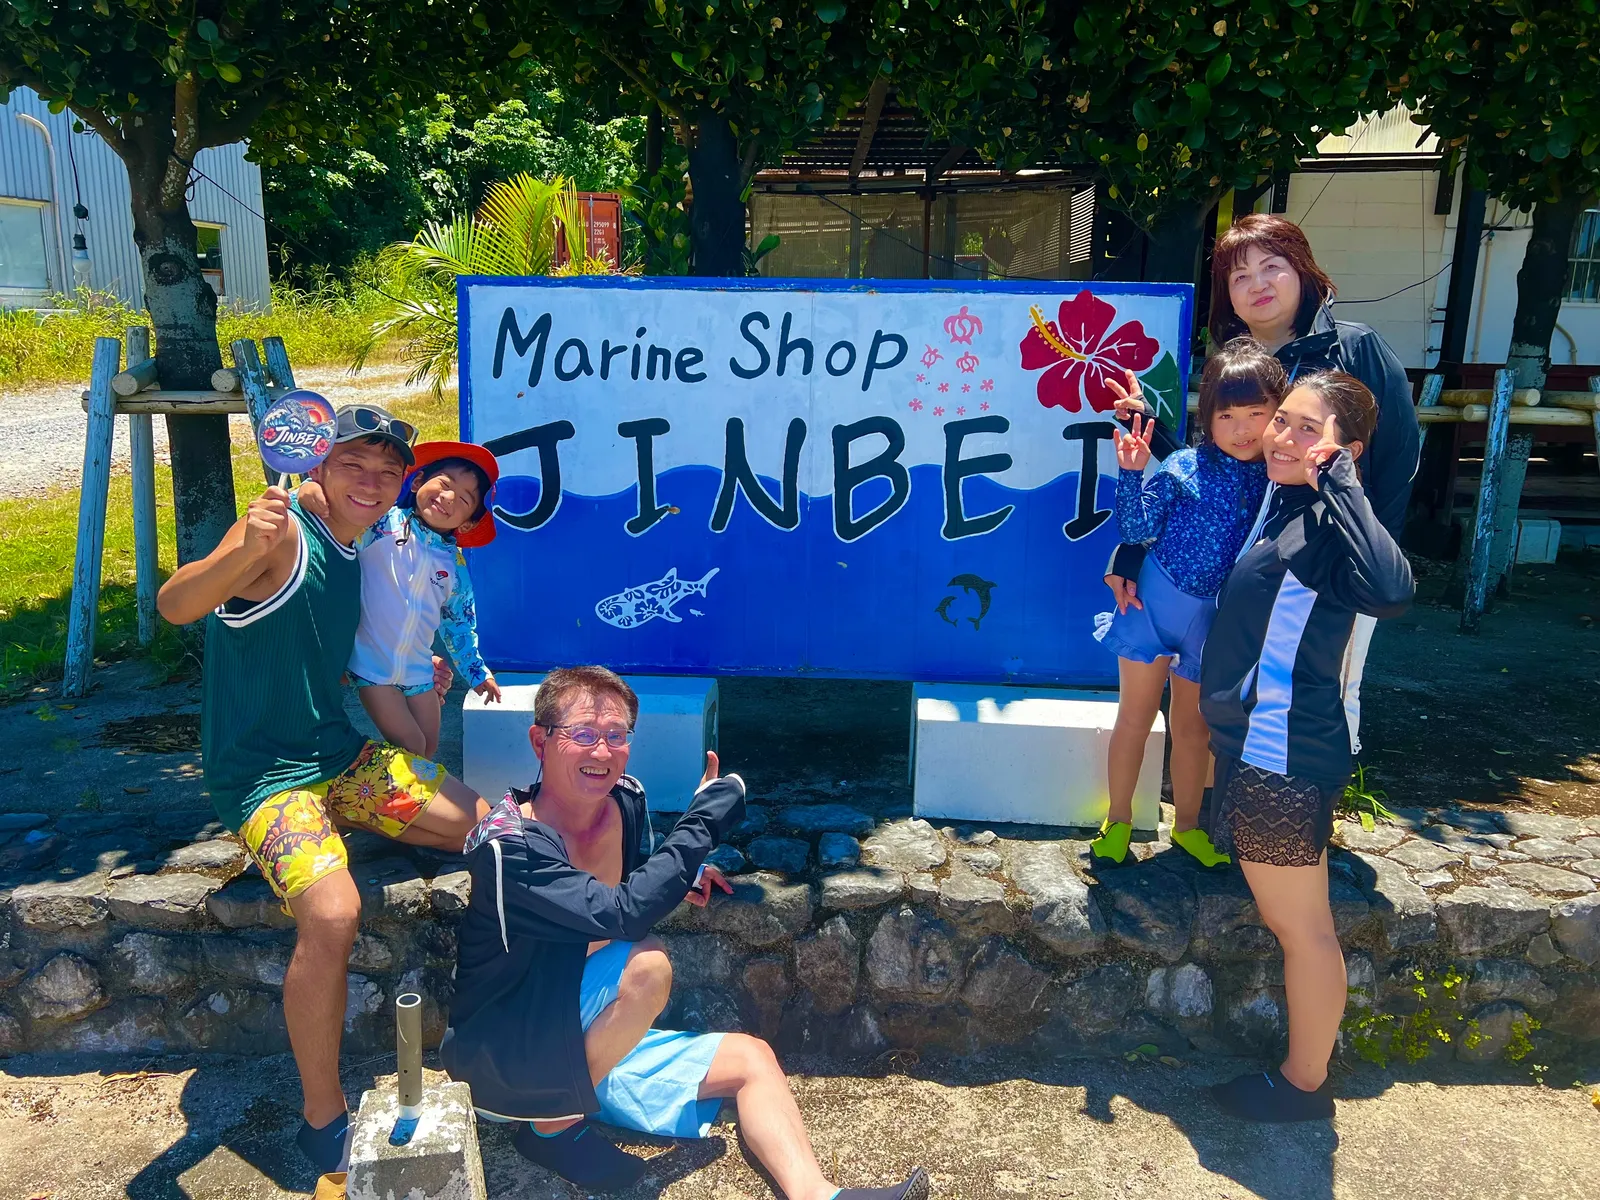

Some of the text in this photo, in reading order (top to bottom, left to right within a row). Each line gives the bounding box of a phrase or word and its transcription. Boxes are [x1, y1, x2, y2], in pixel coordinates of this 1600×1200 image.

[492, 306, 908, 392] Marine Shop
[264, 426, 322, 447] JINBEI
[481, 416, 1117, 541] JINBEI
